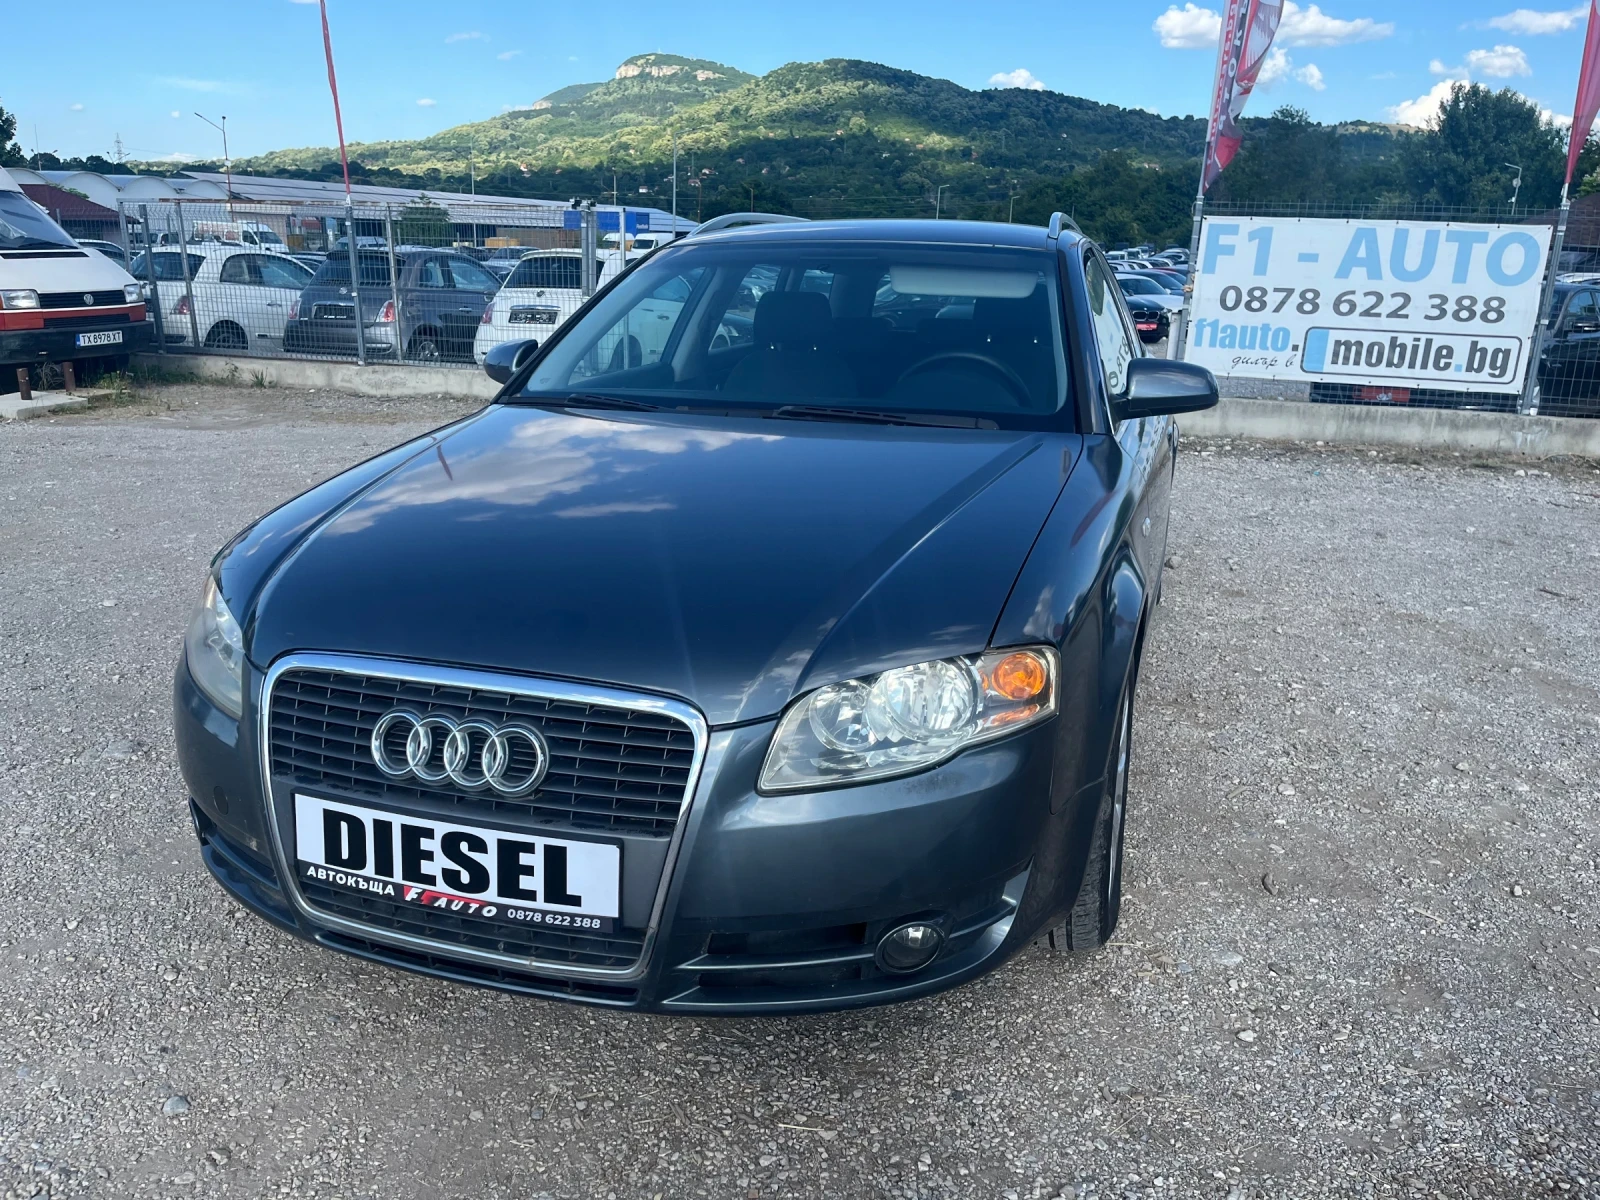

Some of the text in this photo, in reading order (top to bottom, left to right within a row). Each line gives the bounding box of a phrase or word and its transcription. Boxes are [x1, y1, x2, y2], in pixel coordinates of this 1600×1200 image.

[1202, 223, 1541, 286] F1 - AUTO
[1219, 285, 1507, 324] 0878 622 388
[1331, 336, 1512, 378] mobile.bg
[322, 807, 582, 908] DIESEL
[306, 866, 396, 897] АВТОКЪЩА
[434, 896, 498, 918] AUTO
[507, 908, 542, 924] 0878
[545, 913, 571, 926] 622
[573, 915, 601, 929] 388
